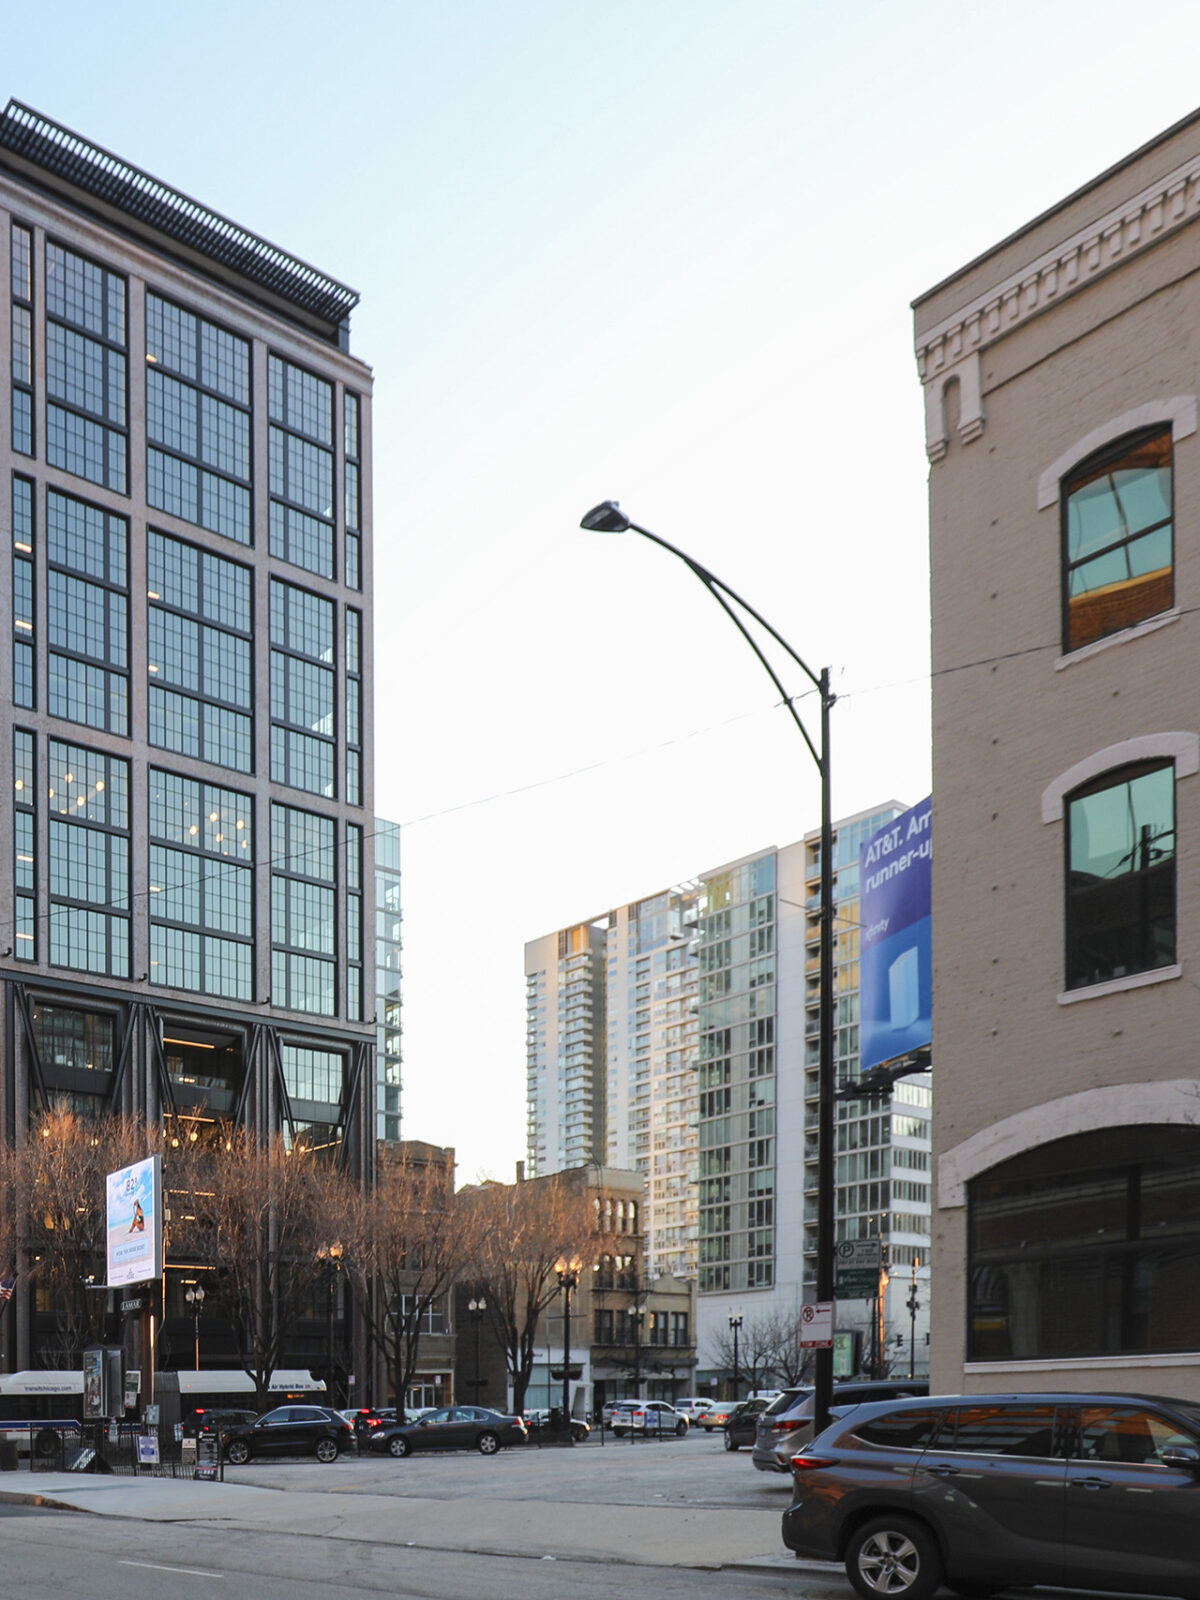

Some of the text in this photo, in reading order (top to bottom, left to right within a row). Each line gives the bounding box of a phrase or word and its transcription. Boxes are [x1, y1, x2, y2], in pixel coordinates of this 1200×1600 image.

[865, 826, 904, 868] AT&T.
[866, 838, 932, 893] runner-u
[865, 917, 890, 940] xfinity
[24, 1384, 72, 1392] transitchicago.com
